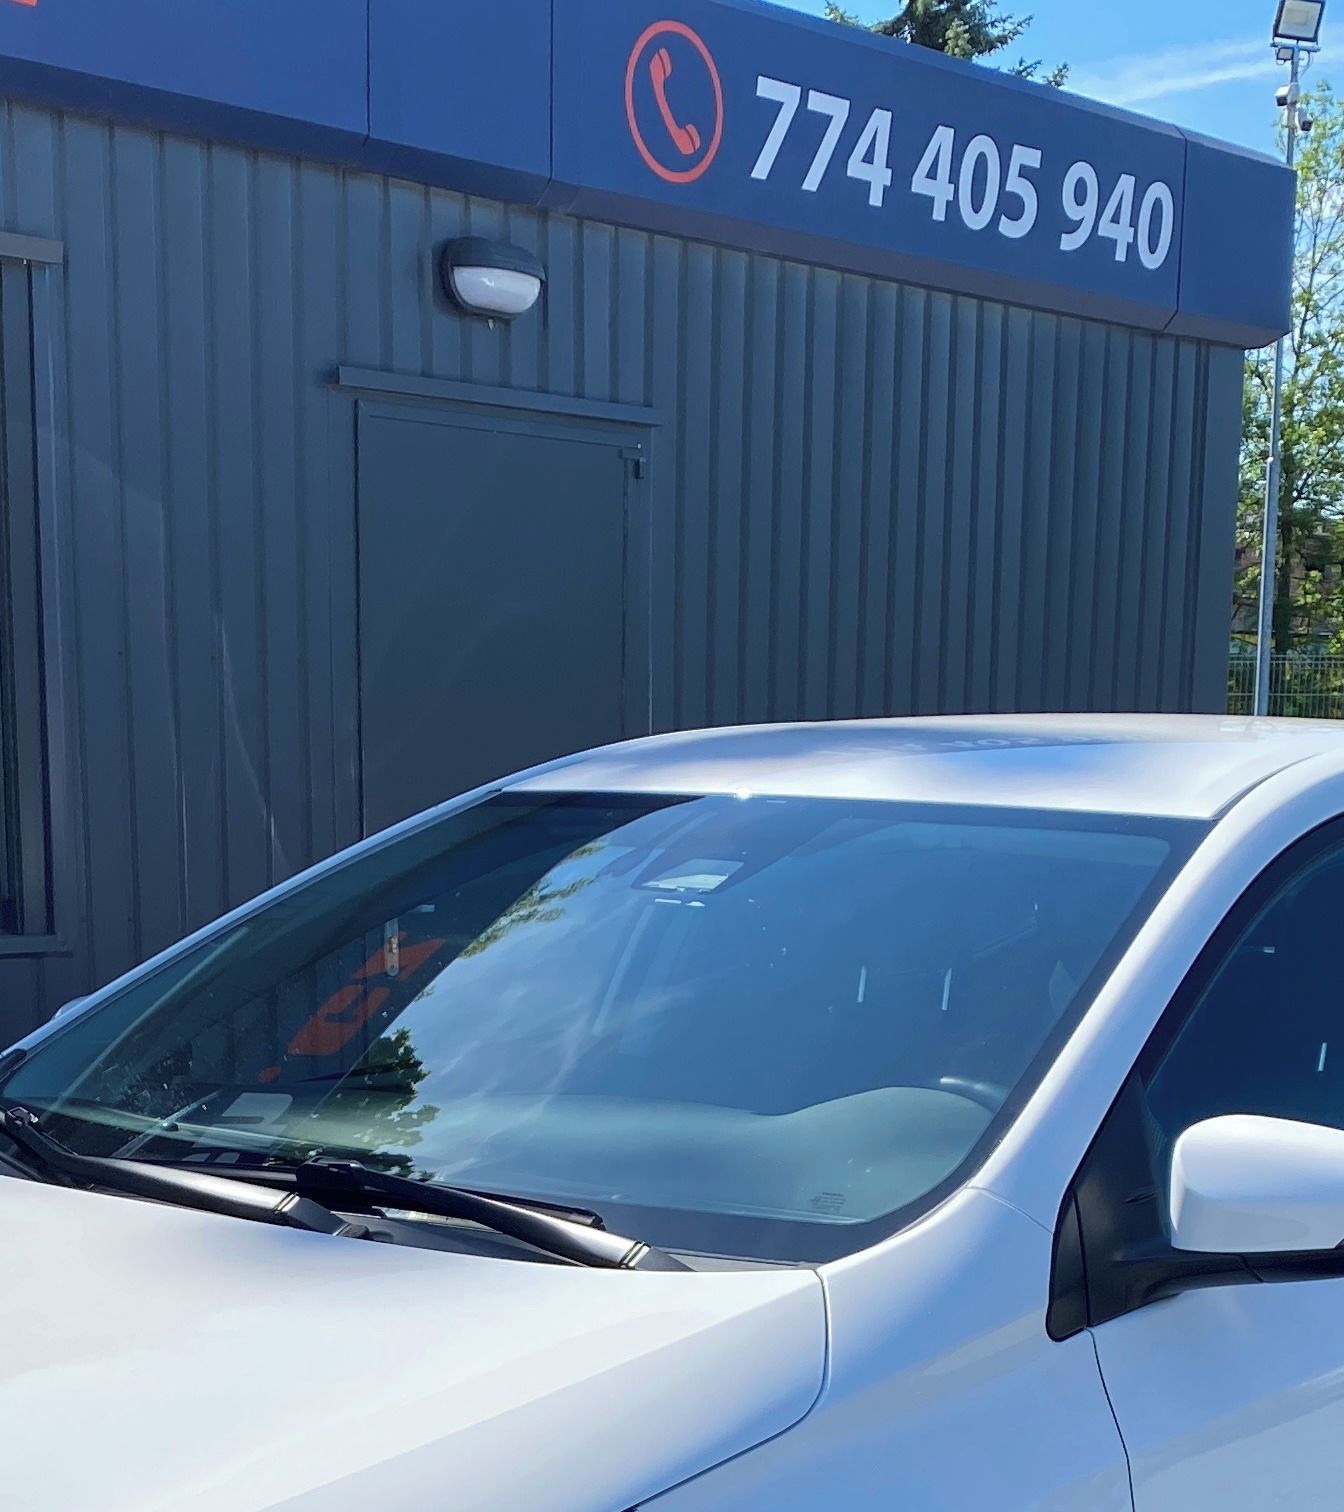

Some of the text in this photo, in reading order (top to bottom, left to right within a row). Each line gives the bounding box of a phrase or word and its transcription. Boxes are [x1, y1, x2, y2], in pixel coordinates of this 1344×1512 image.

[751, 75, 1174, 270] 774 405 940
